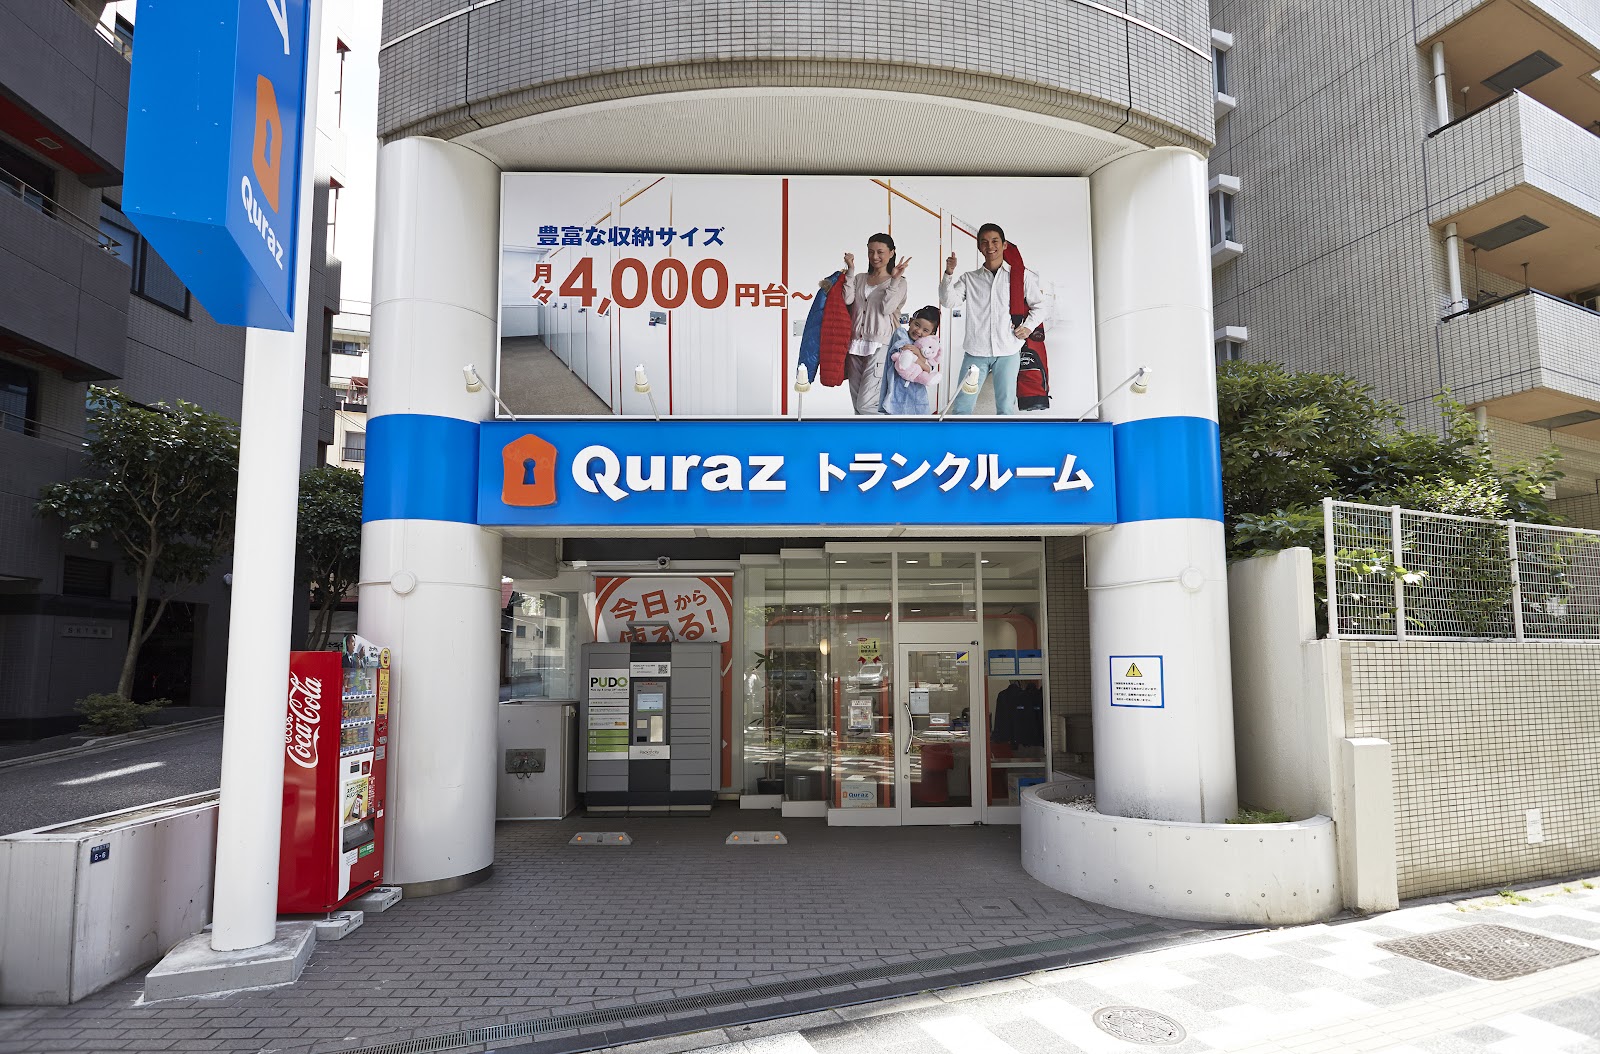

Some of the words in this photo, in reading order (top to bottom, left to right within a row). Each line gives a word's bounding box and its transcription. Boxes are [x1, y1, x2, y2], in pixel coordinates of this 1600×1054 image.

[241, 175, 284, 270] Quraz
[538, 226, 725, 247] 豊富な収納サイズ
[572, 446, 787, 502] Quraz
[819, 452, 1094, 492] トランクルーム
[610, 589, 708, 623] 今日から
[591, 677, 628, 688] PUDO
[287, 671, 322, 769] Coca-Cola
